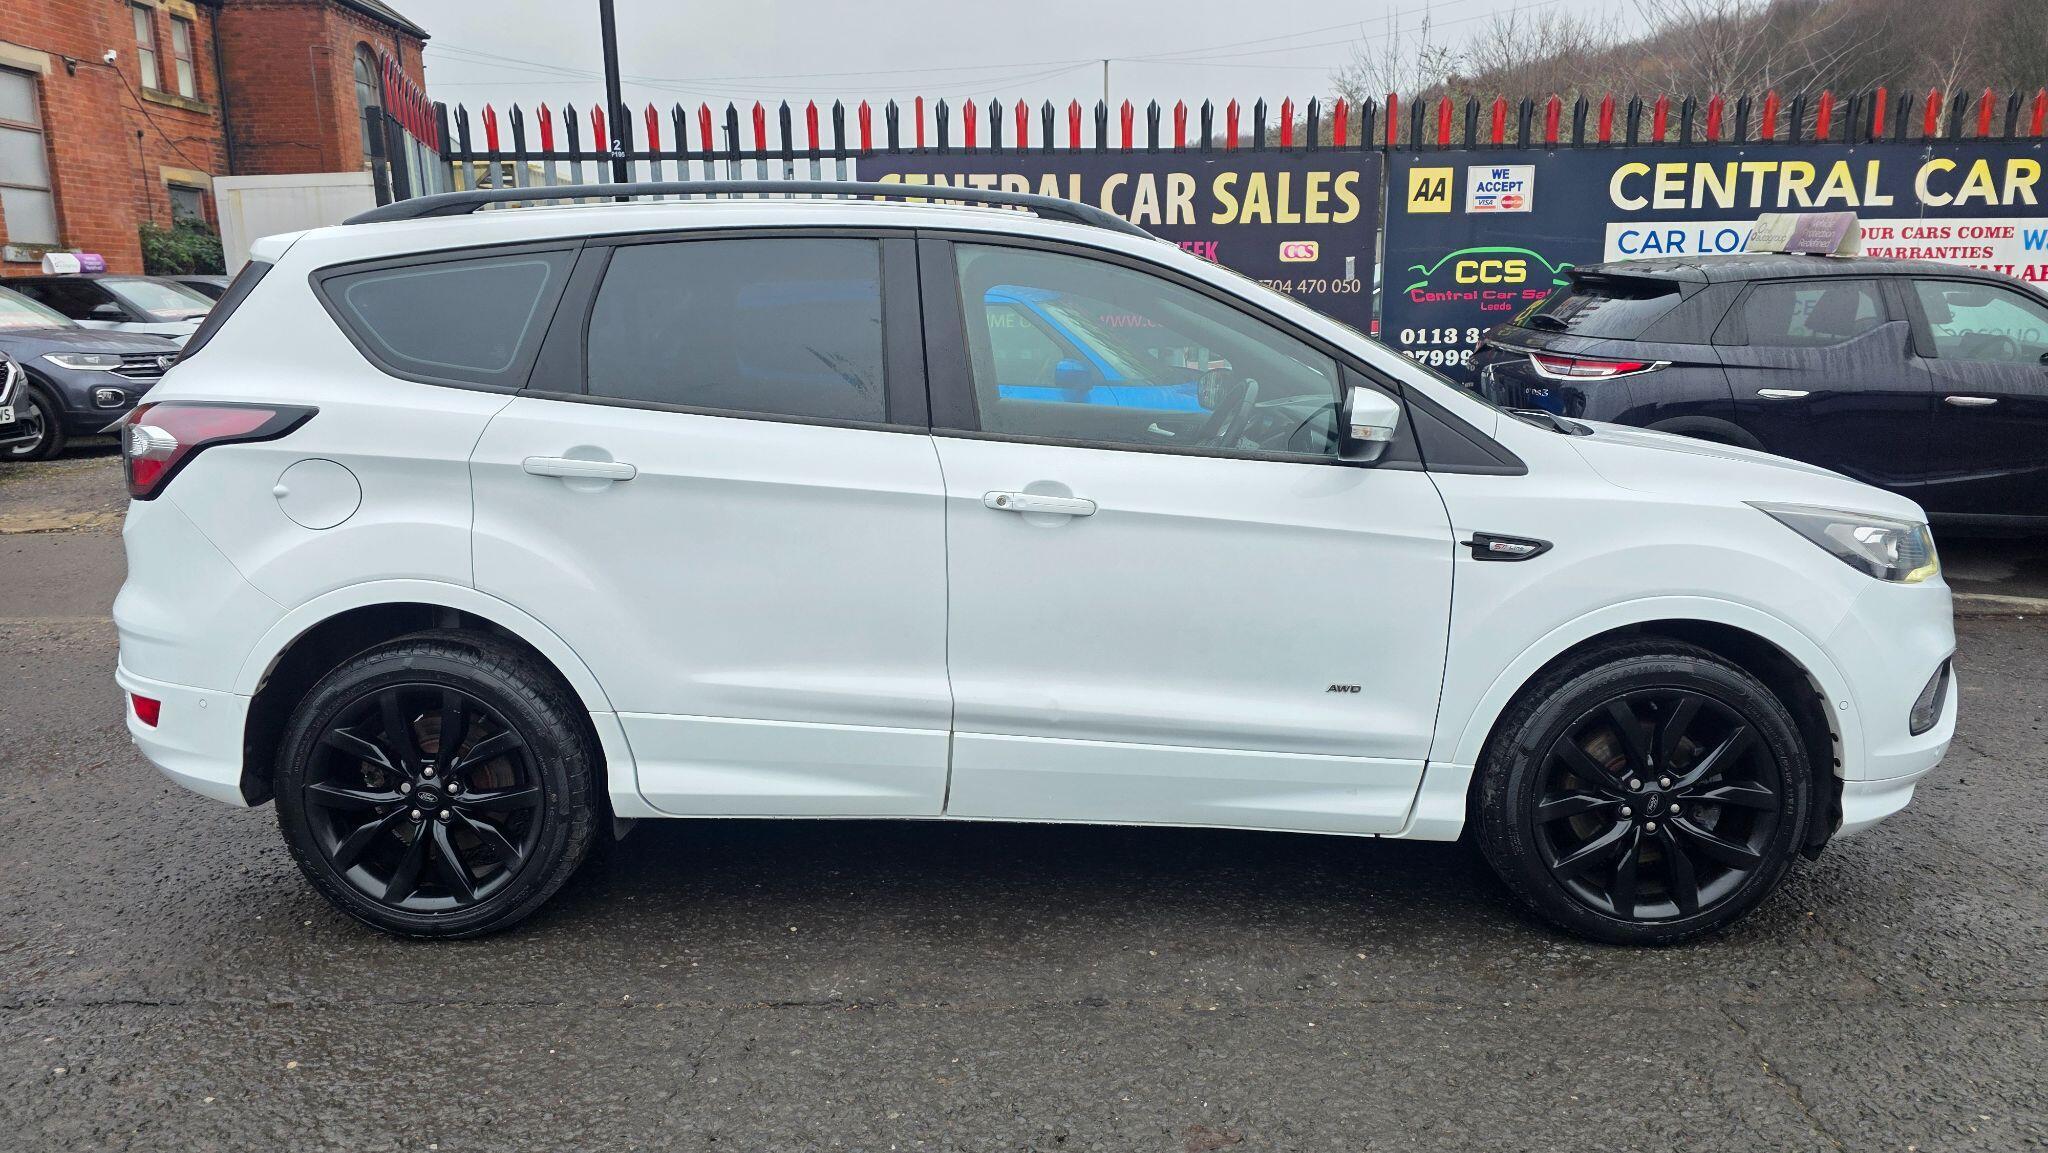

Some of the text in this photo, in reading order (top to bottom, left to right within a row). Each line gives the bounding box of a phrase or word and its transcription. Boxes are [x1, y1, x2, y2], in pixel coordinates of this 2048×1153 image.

[613, 140, 621, 150] 2
[1492, 169, 1509, 179] WE
[1412, 177, 1446, 201] AA
[1476, 181, 1524, 192] ACCEPT
[1609, 158, 2041, 211] CENTRAL CAR
[1100, 172, 1197, 225] CAR
[1211, 170, 1361, 225] SALES
[1901, 226, 1952, 239] CARS
[1957, 226, 2015, 239] COME
[2023, 229, 2048, 251] W
[1617, 229, 1686, 254] CAR
[1698, 228, 1754, 253] LO
[1283, 244, 1316, 259] CCS
[1866, 246, 1994, 259] WARRANTIES
[1455, 259, 1527, 284] CCS
[1296, 279, 1327, 294] 470
[1331, 278, 1361, 293] 050
[1410, 288, 1552, 303] Central Car Sa
[1480, 301, 1512, 311] Leeds
[1400, 327, 1491, 344] 0113 3
[0, 408, 11, 421] S
[1325, 684, 1362, 693] AWD
